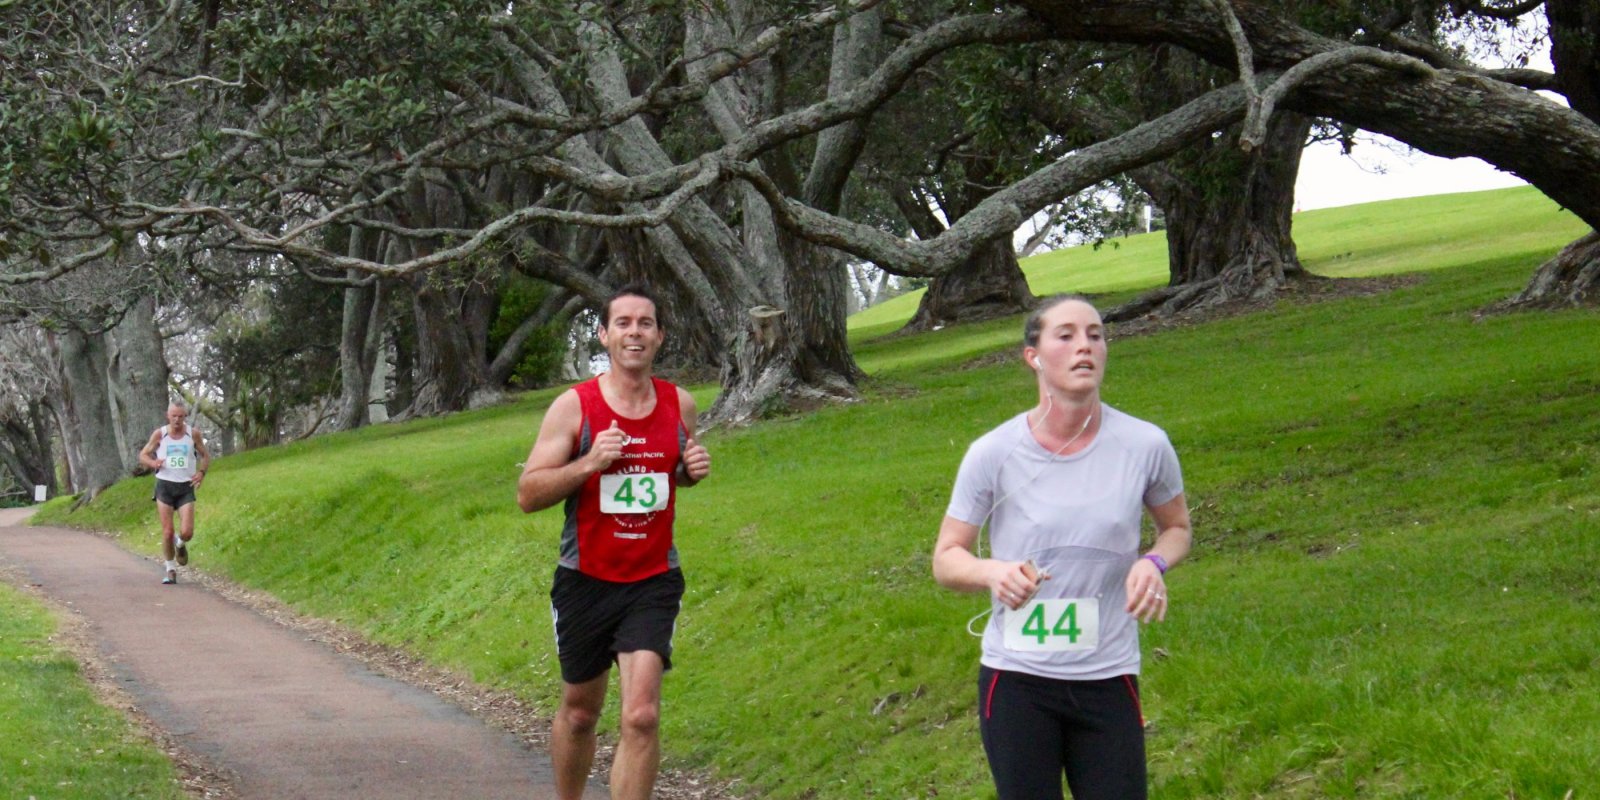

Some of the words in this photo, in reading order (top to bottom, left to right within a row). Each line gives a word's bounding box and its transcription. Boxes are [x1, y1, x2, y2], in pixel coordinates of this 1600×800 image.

[170, 457, 185, 467] 56
[614, 476, 657, 508] 43
[1022, 602, 1082, 644] 44
